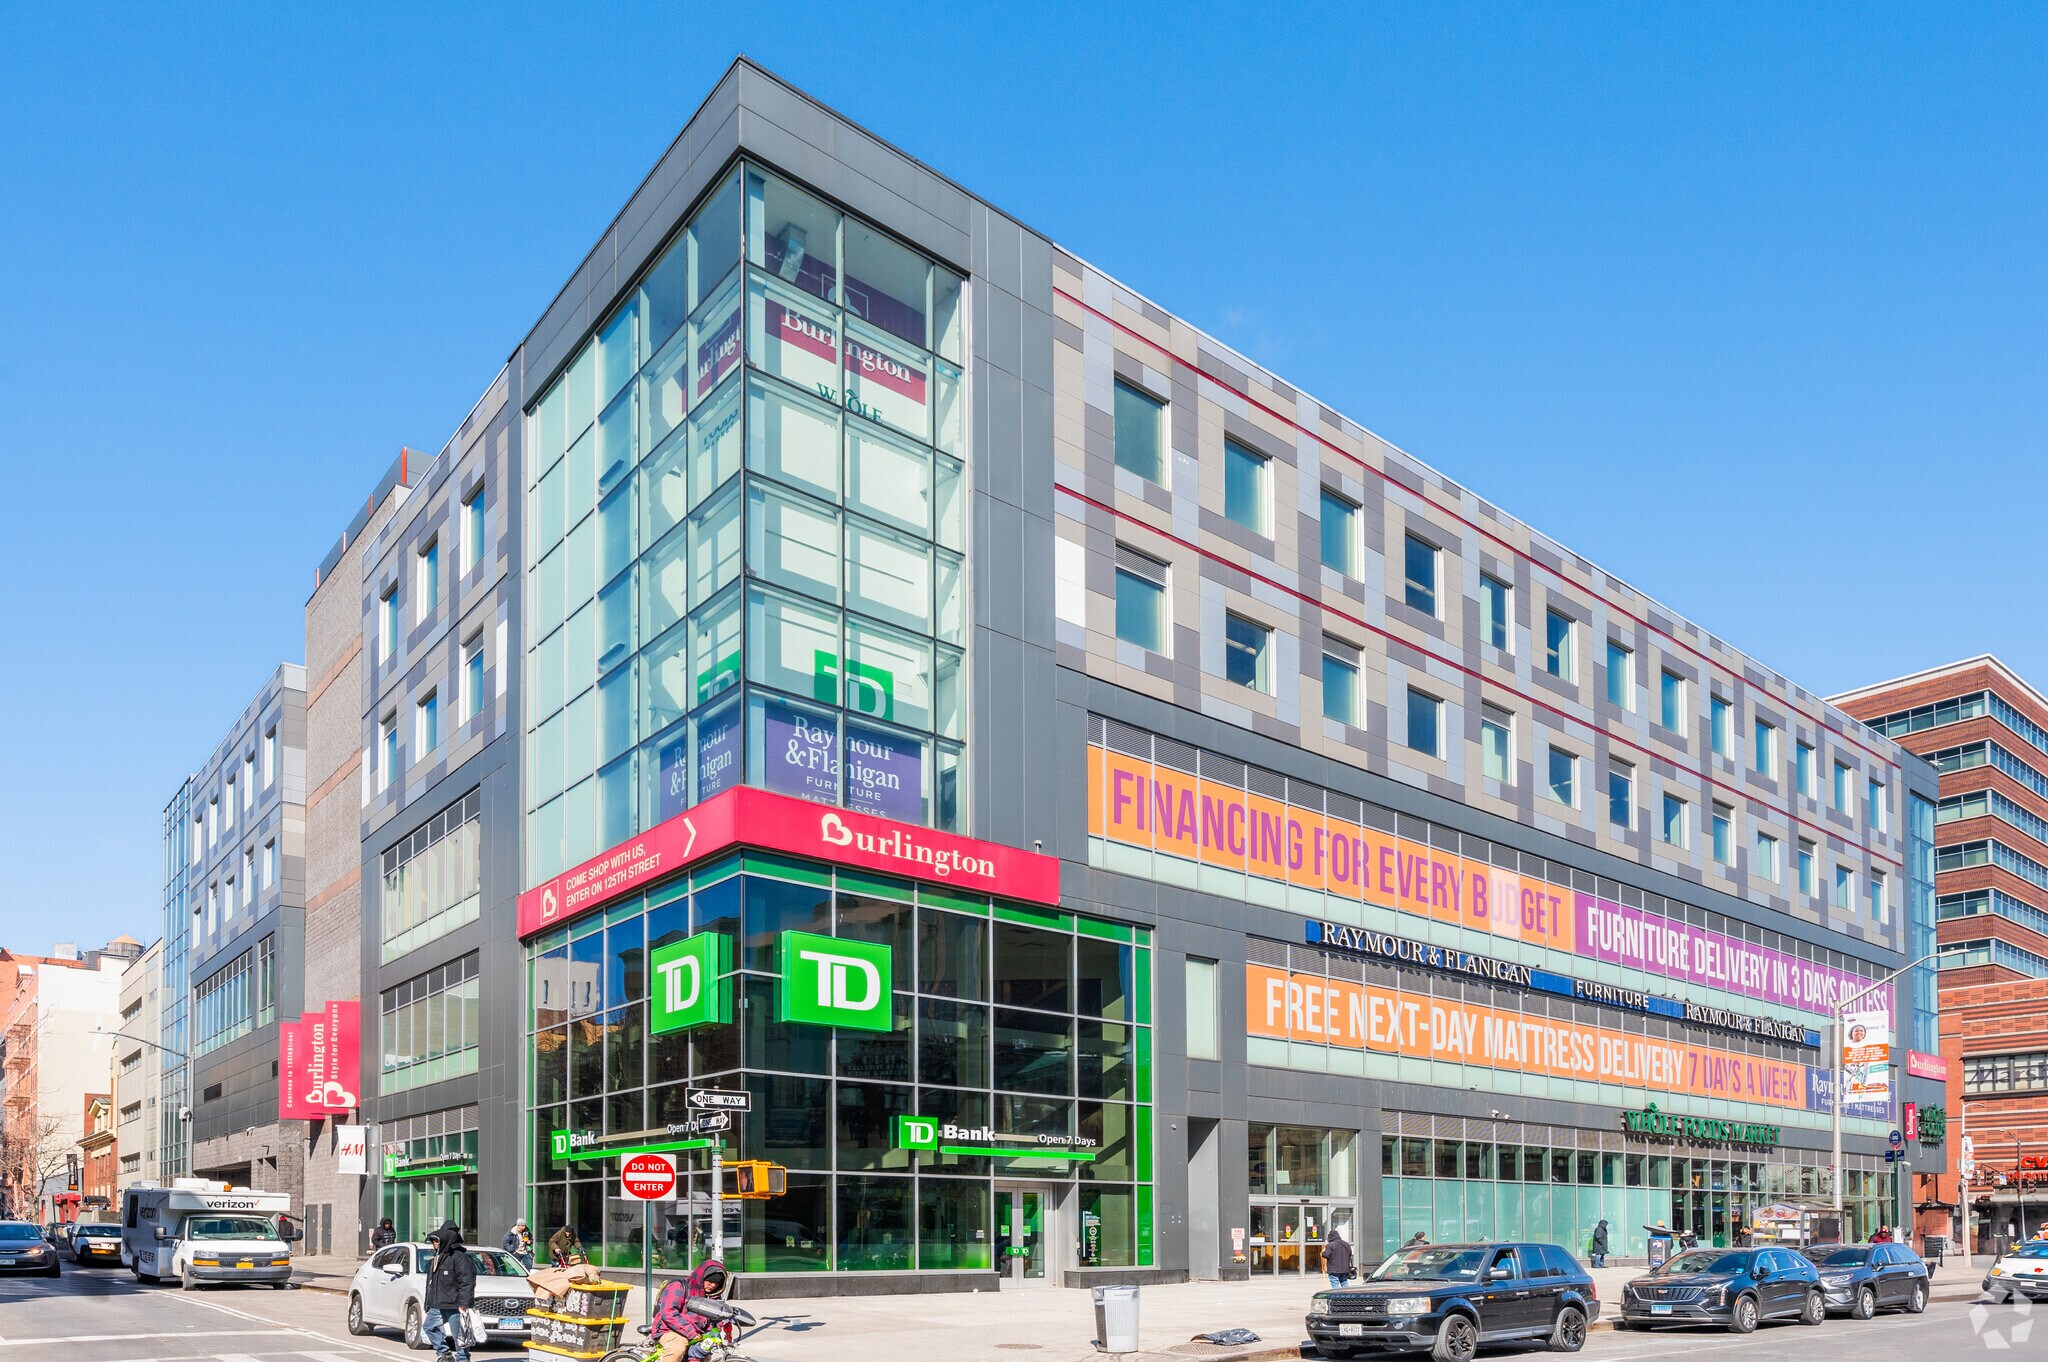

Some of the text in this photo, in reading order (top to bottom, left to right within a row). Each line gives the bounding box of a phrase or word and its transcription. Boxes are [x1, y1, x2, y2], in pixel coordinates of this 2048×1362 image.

[697, 325, 740, 382] urlingt
[782, 305, 911, 383] Burlngton
[816, 382, 882, 424] WOLE
[806, 776, 882, 801] FURNTURE
[821, 813, 996, 878] Burlington
[1113, 768, 1562, 937] FINANCING FOR EVERY BUDGET
[566, 843, 646, 891] COME SHOP WITH US,
[566, 853, 661, 907] ENTER ON 125TH STREET
[1321, 921, 1532, 985] RAYMOUR & FLANIGAN
[1587, 906, 1690, 972] FURNITURE
[1694, 937, 1769, 991] DELIVERY
[1773, 959, 1788, 996] IN
[1791, 965, 1801, 999] 3
[1803, 969, 1837, 1009] DAYS
[1840, 979, 1856, 1012] OR
[657, 954, 700, 1014] TD
[800, 950, 881, 1011] TD
[1576, 979, 1650, 1008] FURNITURE
[1266, 977, 1798, 1102] FREE NEXT-DAY MATTRESS DELIVERY 7 DAYS A WEEK
[1686, 1003, 1806, 1043] RAYMOUR & FLANIGAN
[305, 1023, 325, 1103] Burlington
[1910, 1054, 1947, 1076] Burlington
[696, 1095, 742, 1105] ONE WAY
[553, 1135, 567, 1154] TD
[570, 1131, 595, 1147] Bank
[667, 1123, 685, 1136] Open
[685, 1122, 690, 1132] 7
[904, 1122, 1096, 1148] TD Bank Open 7 Days
[1625, 1108, 1781, 1145] WHOLE FOODS MARKET
[341, 1143, 365, 1156] H&M
[631, 1163, 666, 1172] DO NOT
[2021, 1156, 2048, 1169] CV
[206, 1199, 254, 1209] verizon
[634, 1183, 664, 1191] ENTER
